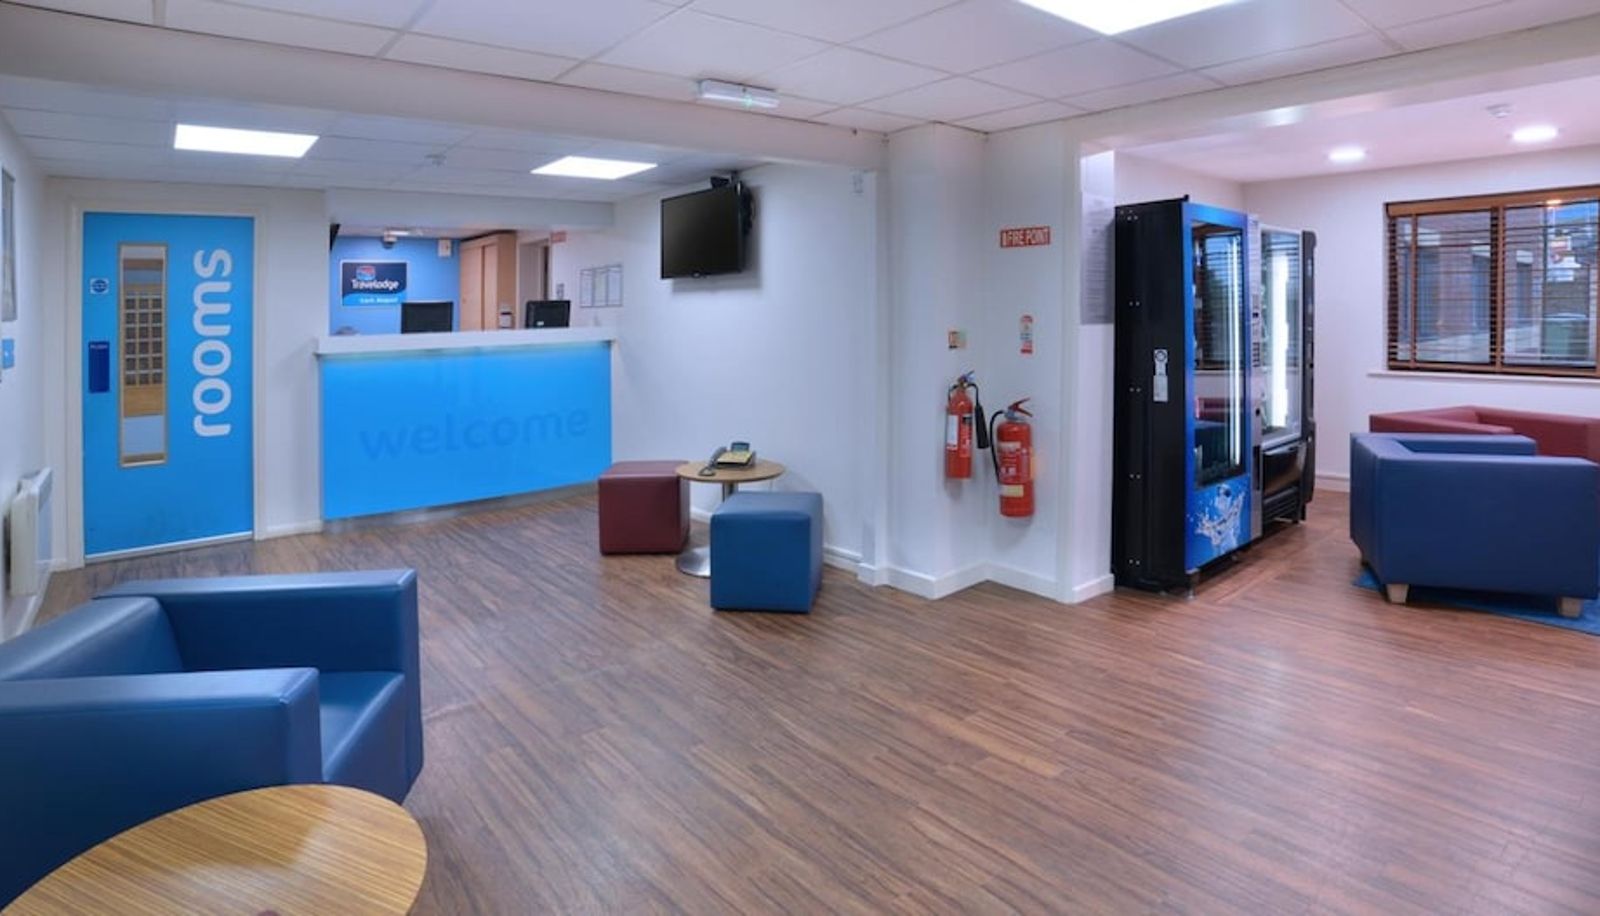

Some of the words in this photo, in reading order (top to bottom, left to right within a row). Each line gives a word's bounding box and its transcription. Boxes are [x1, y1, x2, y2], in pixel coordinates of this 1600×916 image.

[351, 279, 399, 291] Travelodge
[193, 247, 232, 437] rooms
[359, 408, 590, 462] welcome
